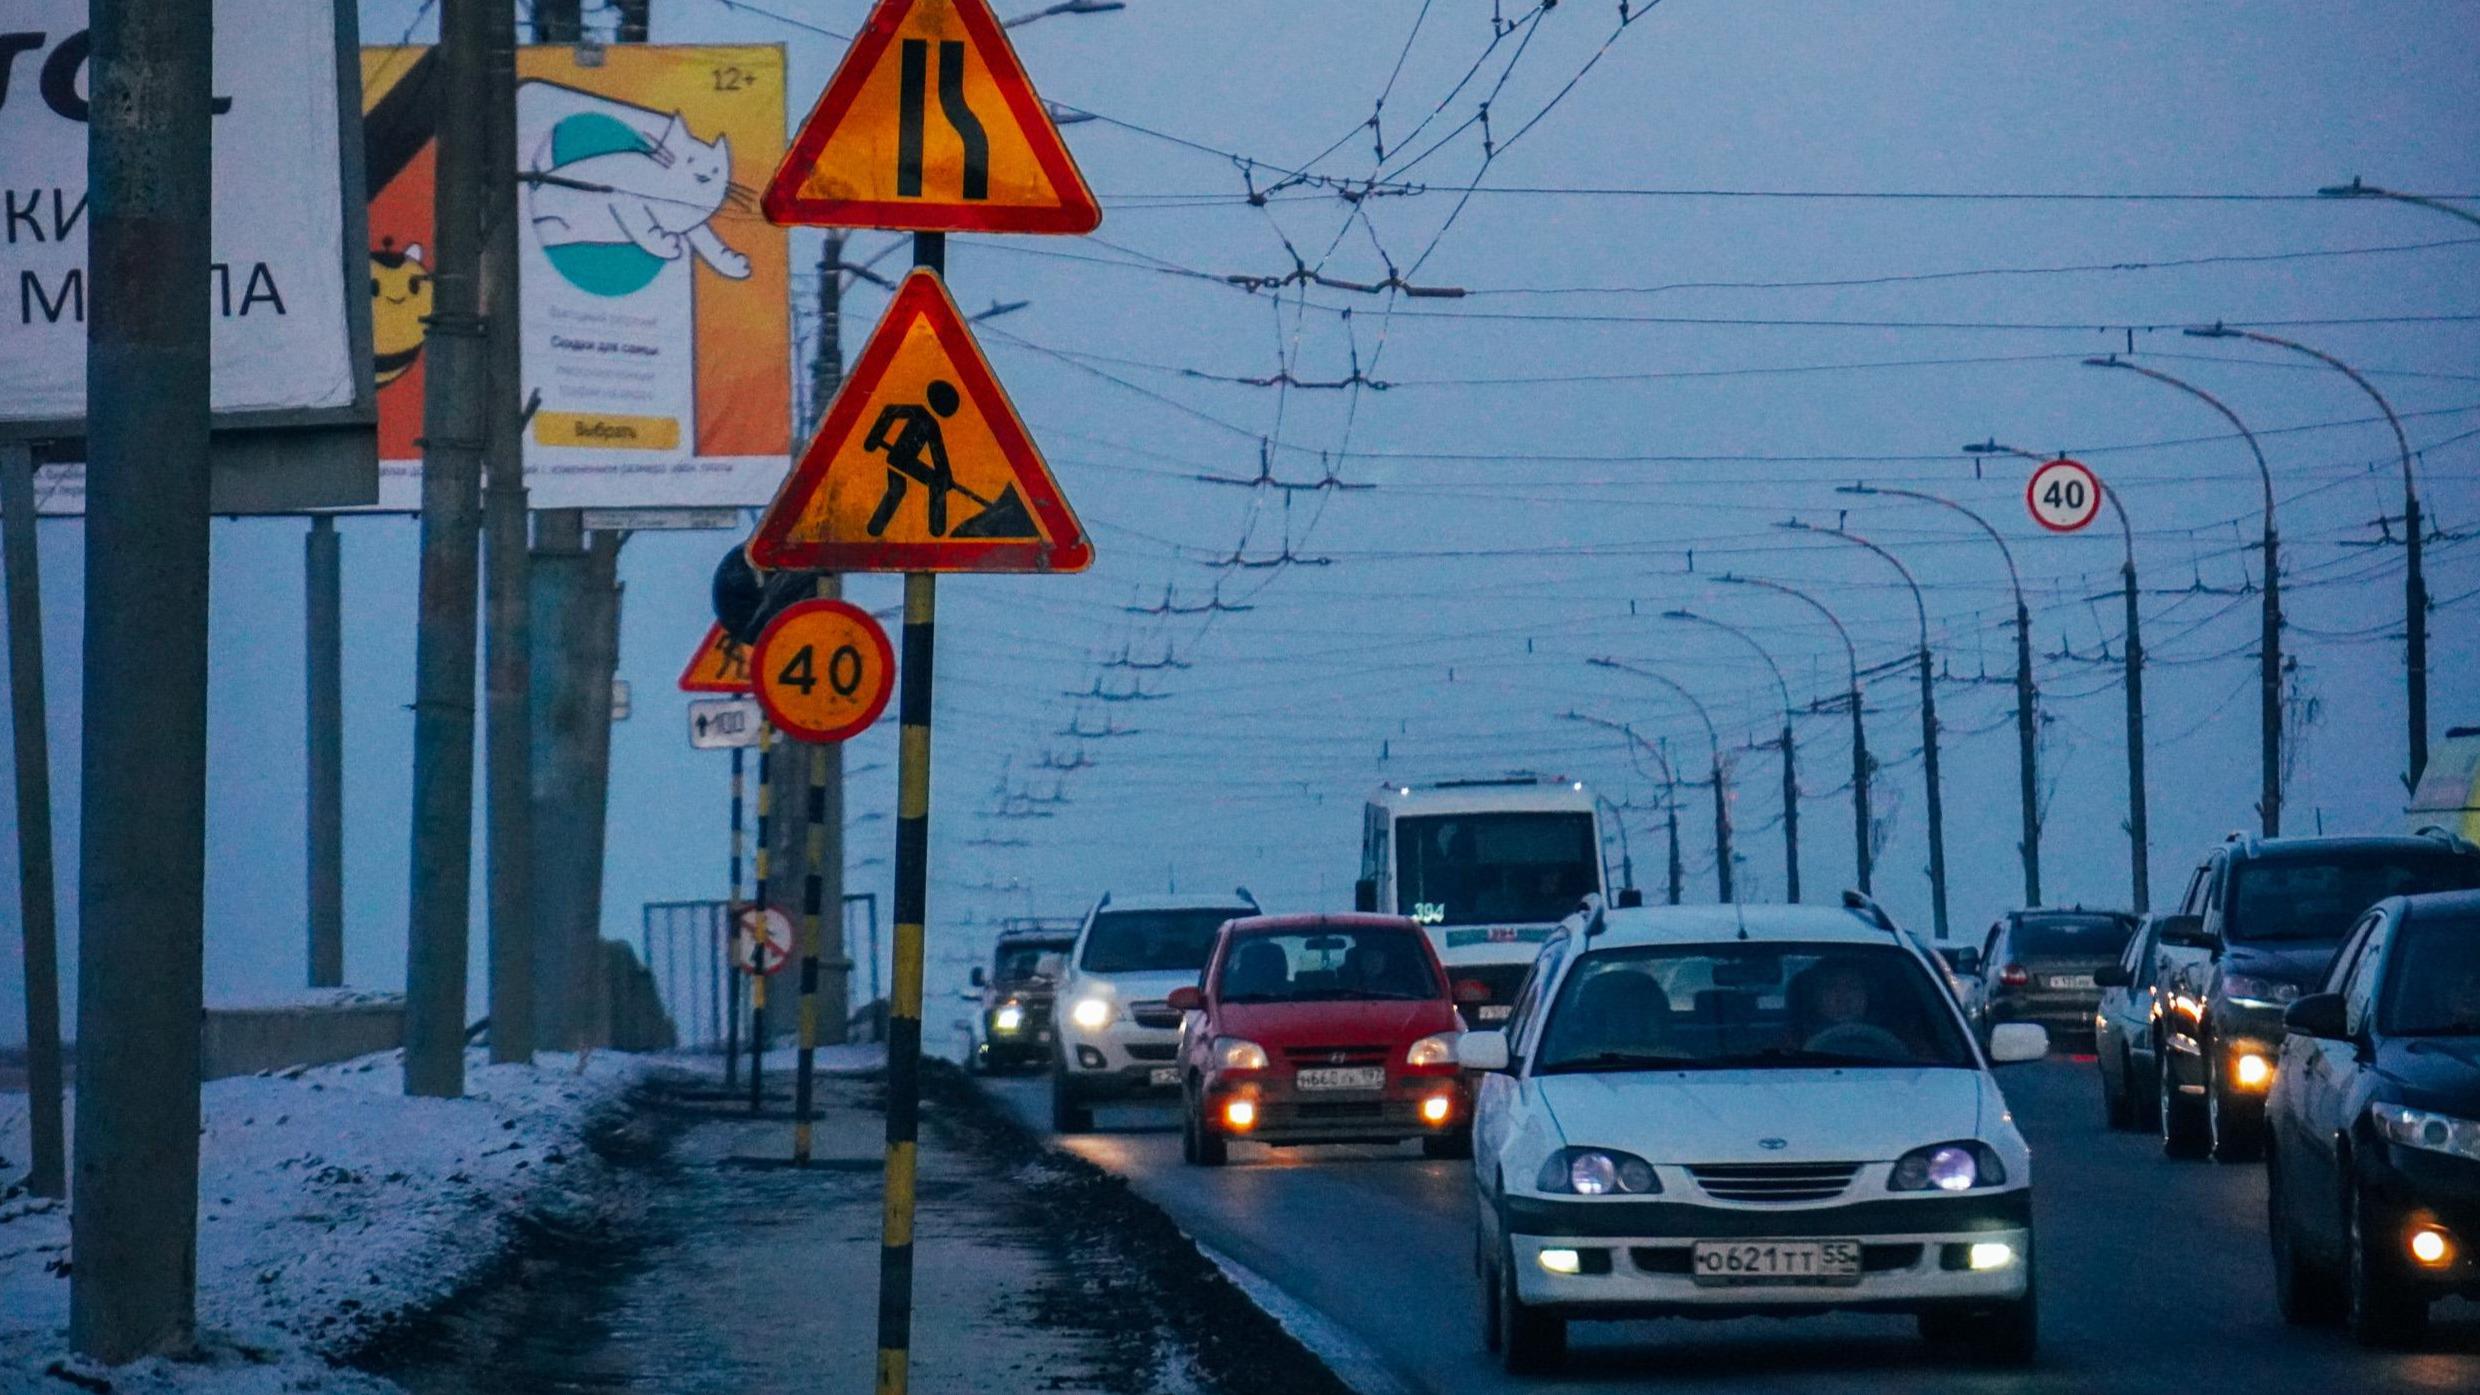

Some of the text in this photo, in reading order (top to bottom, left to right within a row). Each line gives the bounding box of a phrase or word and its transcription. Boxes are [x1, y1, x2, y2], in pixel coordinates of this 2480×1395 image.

[711, 67, 757, 91] 12+
[575, 420, 637, 441] Выбрать
[2043, 480, 2085, 509] 40
[778, 643, 863, 696] 40
[1414, 902, 1445, 923] 394
[1822, 1244, 1849, 1264] 55
